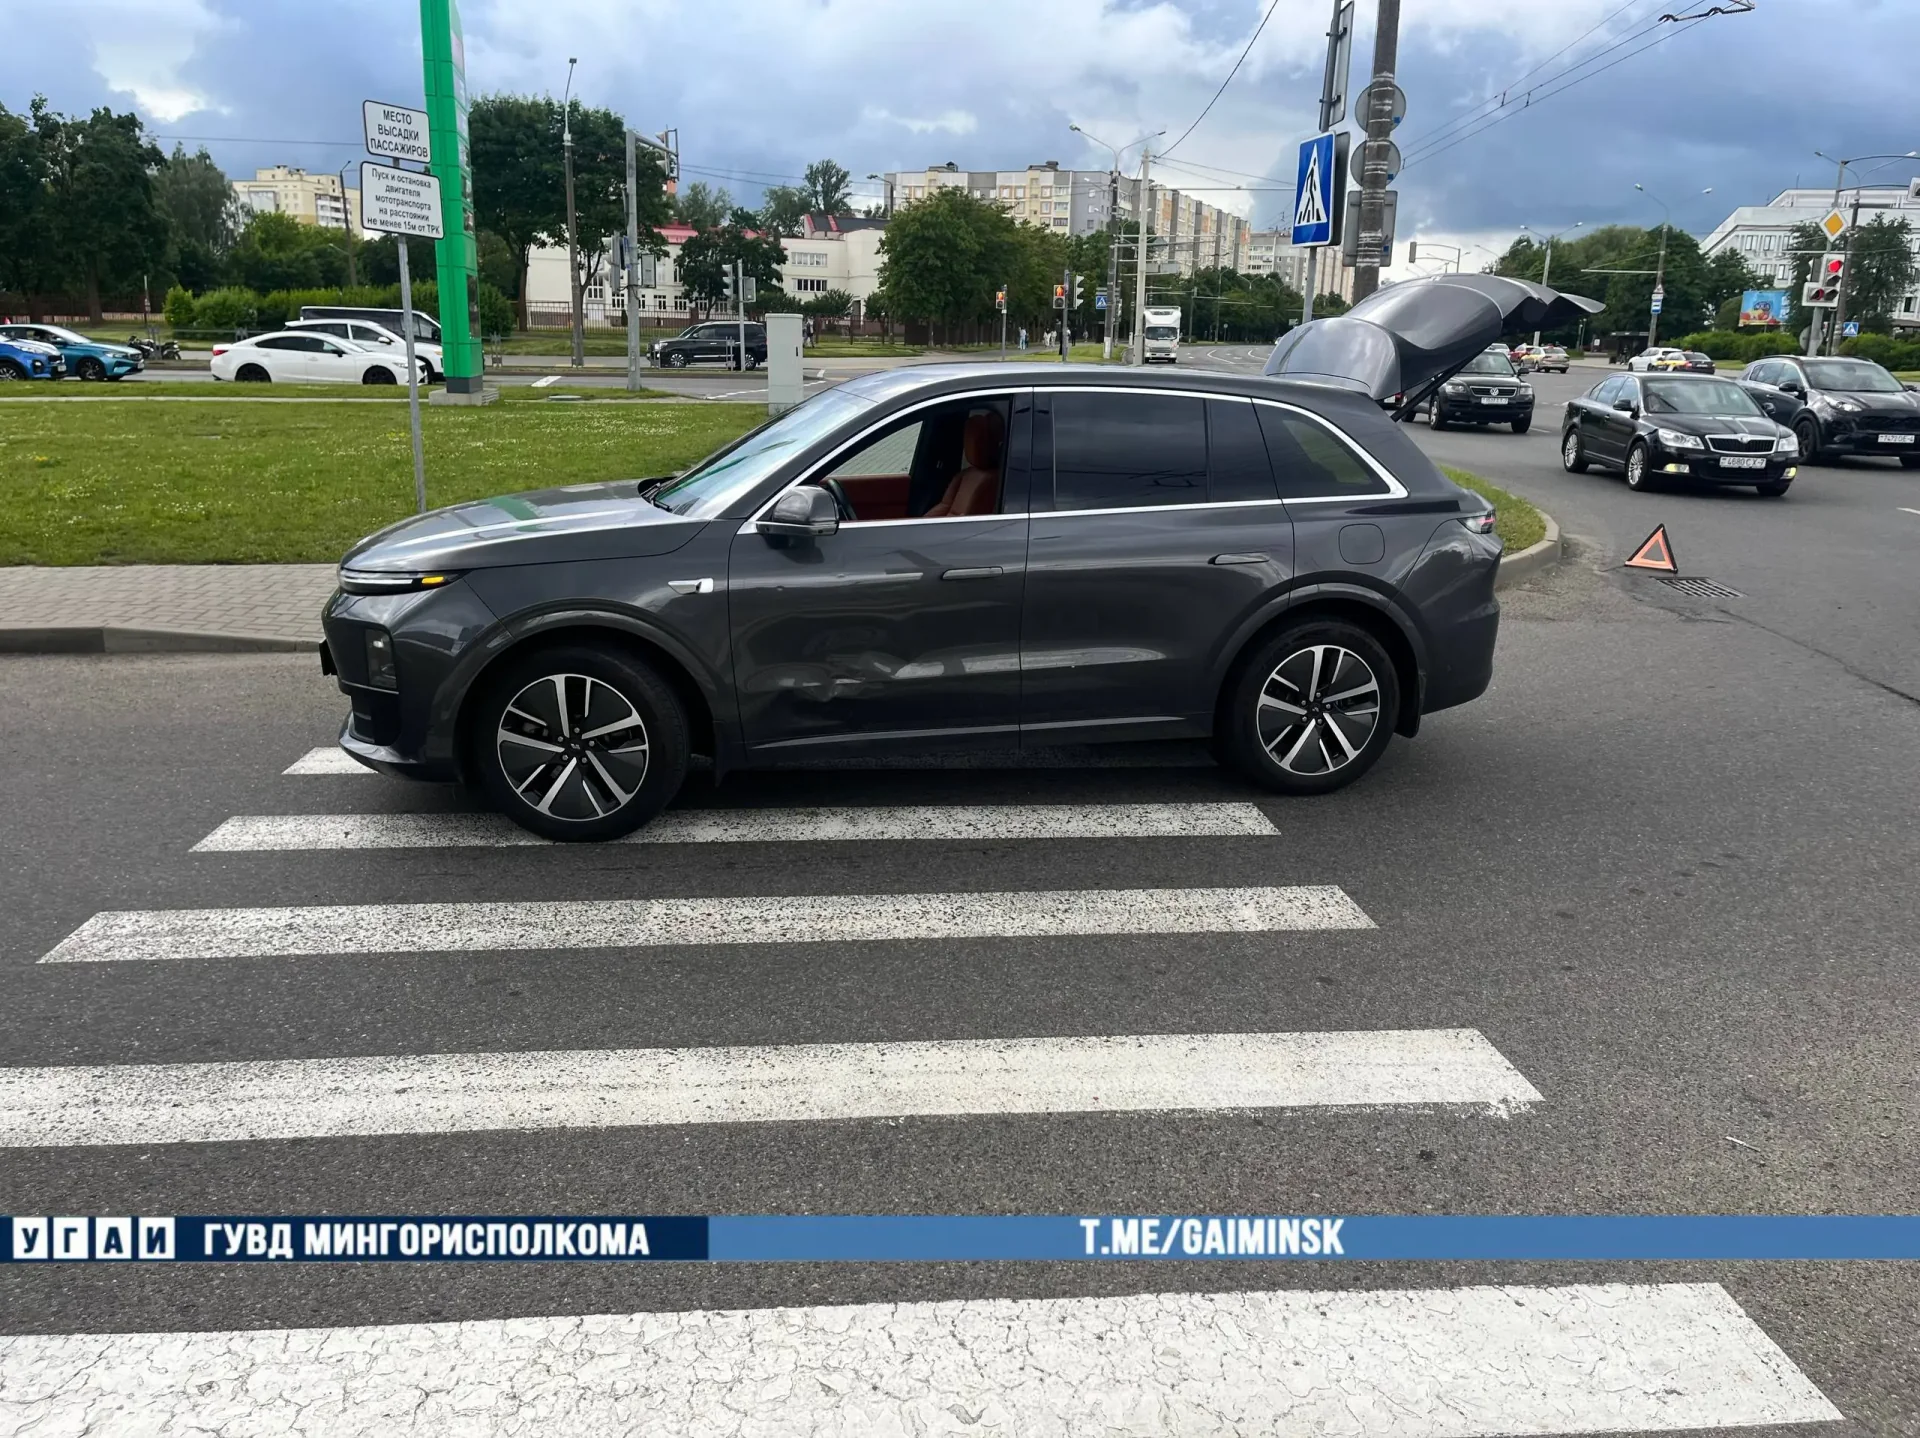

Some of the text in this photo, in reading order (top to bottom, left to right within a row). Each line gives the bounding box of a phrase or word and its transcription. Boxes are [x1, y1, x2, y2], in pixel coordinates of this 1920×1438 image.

[383, 109, 412, 124] МЕСТО
[378, 124, 419, 141] ВЫСАДКИ
[370, 138, 428, 158] ПАССАЖИРОВ
[372, 168, 431, 189] Пуск и остановка
[385, 184, 421, 198] двигателя
[375, 194, 431, 211] мототранспорта
[378, 206, 430, 222] на расстоянии
[367, 217, 440, 235] не менее 15м от ТРК
